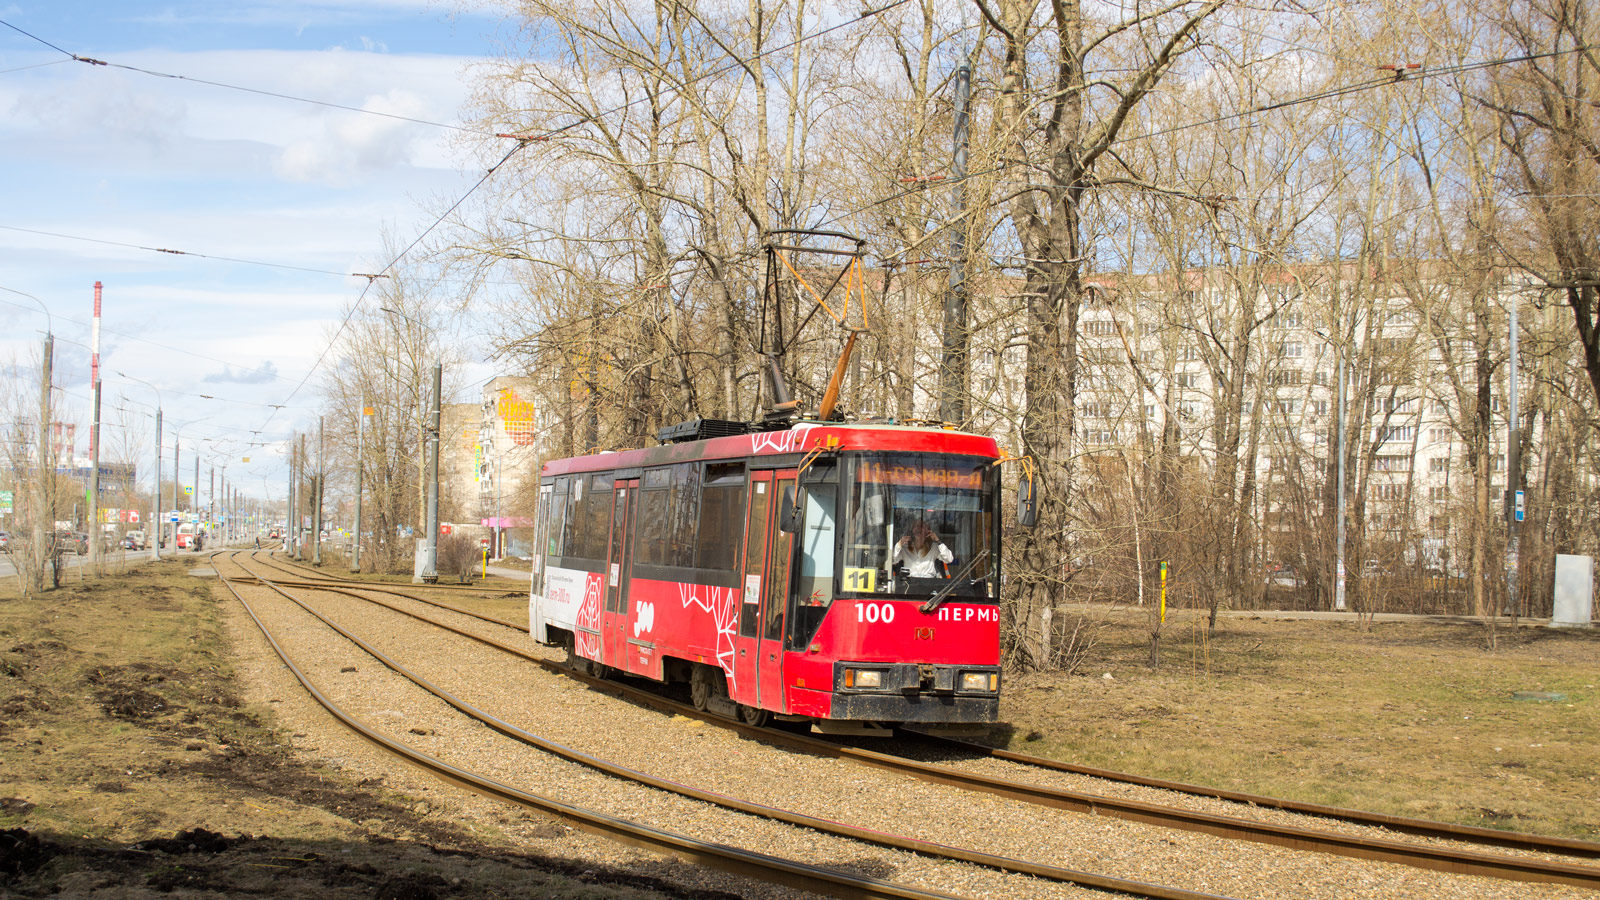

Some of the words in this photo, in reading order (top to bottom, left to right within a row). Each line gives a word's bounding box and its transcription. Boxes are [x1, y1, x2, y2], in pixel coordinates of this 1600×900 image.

[848, 571, 869, 589] 11
[854, 602, 895, 623] 100
[938, 607, 999, 622] ПЕРМЬ
